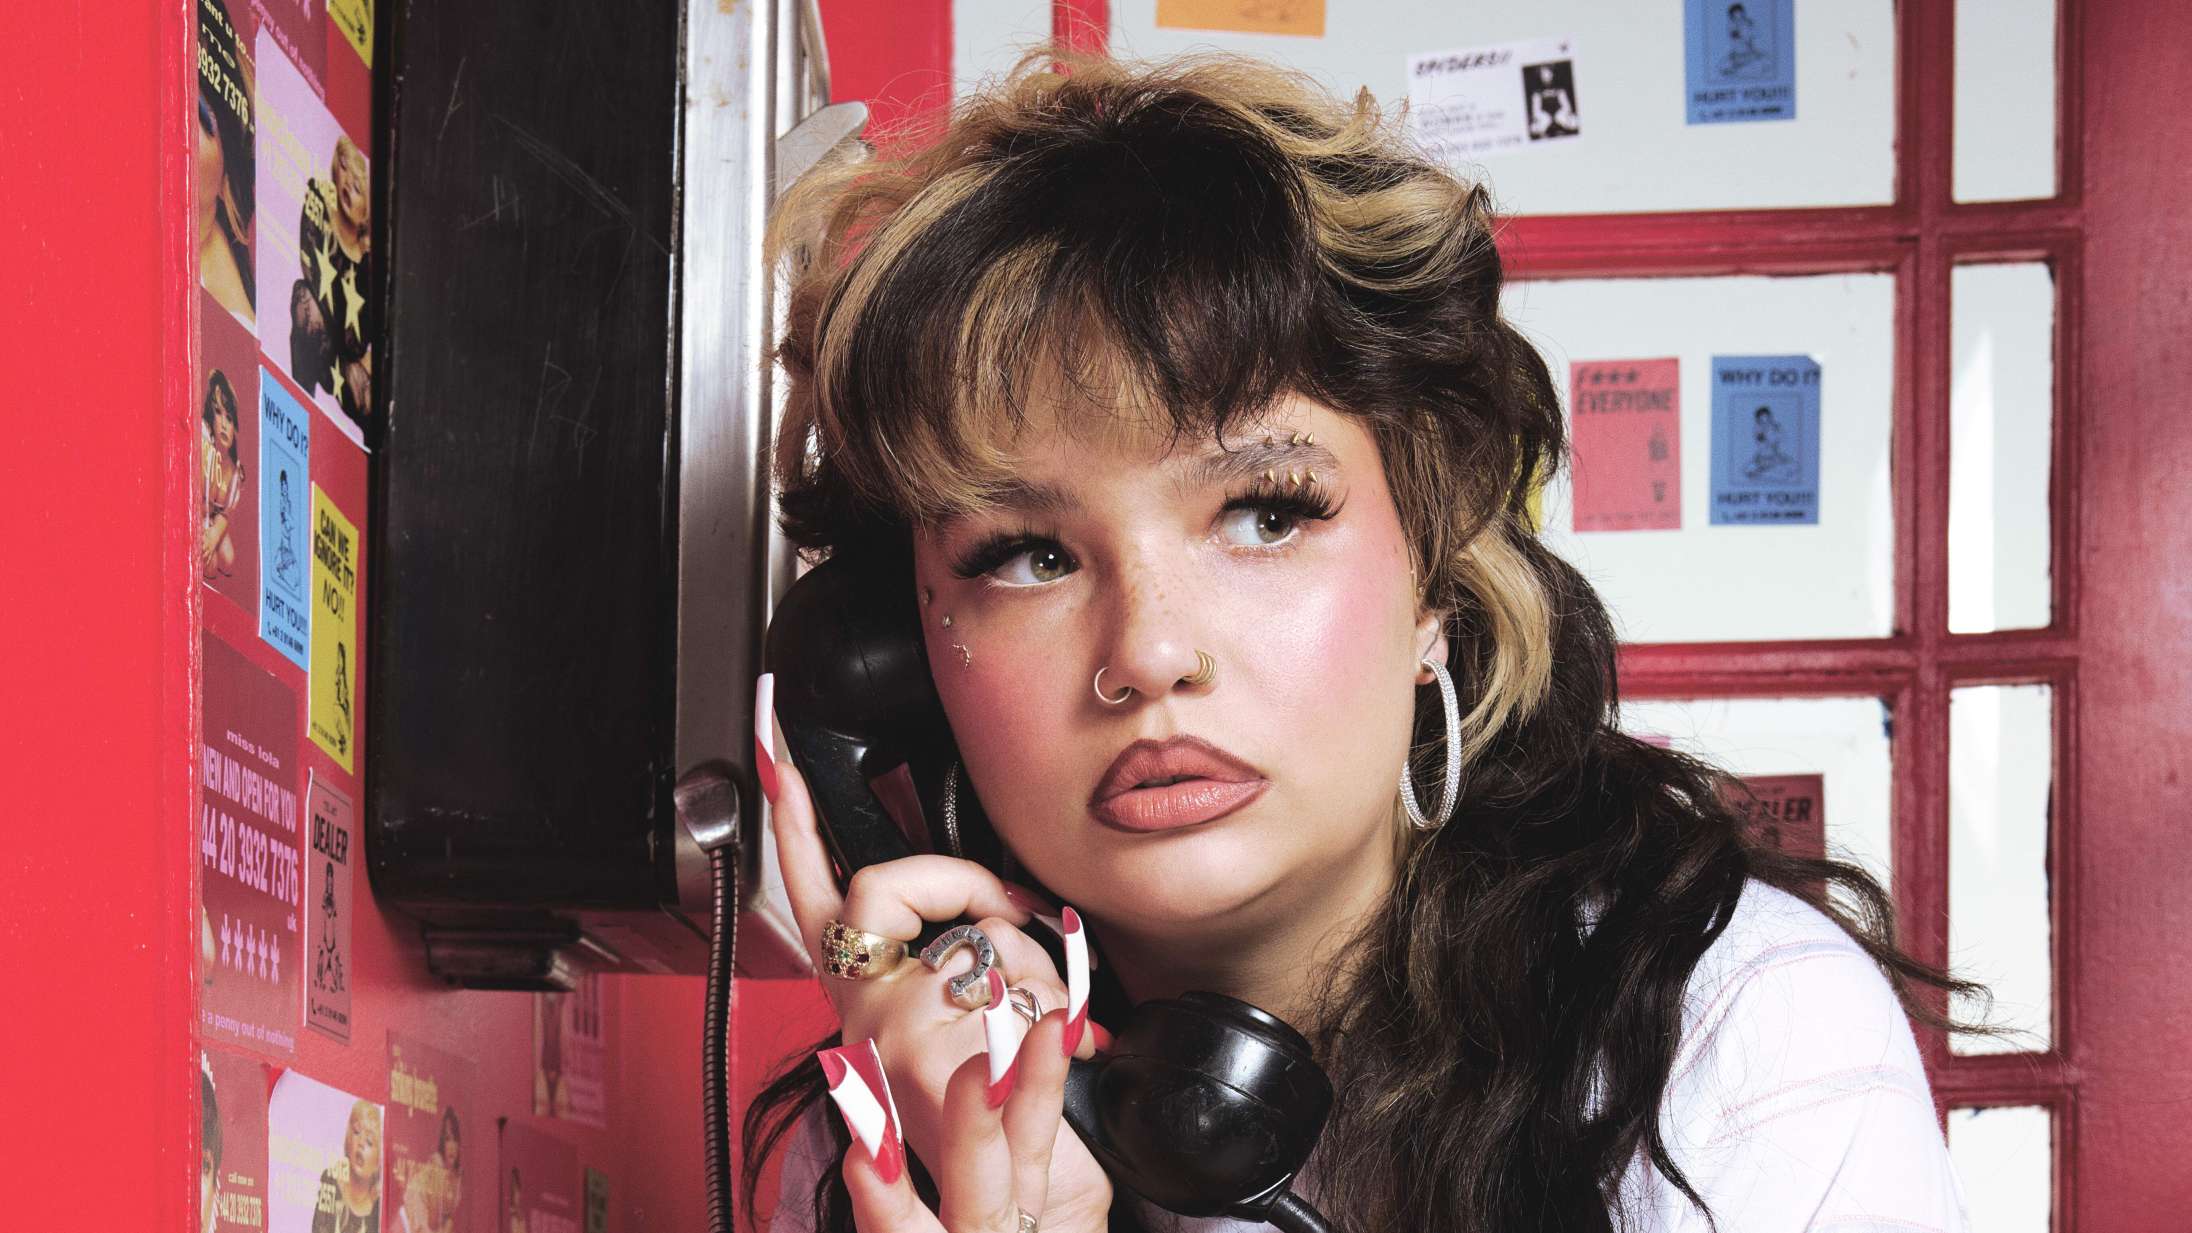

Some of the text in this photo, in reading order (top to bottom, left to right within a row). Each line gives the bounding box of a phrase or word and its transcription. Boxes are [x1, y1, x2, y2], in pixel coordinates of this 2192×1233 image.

[223, 73, 249, 125] 7376
[1719, 368, 1762, 385] WHY
[1768, 367, 1798, 386] DO
[264, 393, 285, 434] WHY
[286, 417, 299, 449] DO
[1576, 387, 1673, 416] EVERYONE
[265, 588, 285, 618] HURT
[226, 729, 280, 770] miss lola
[203, 744, 297, 833] NEW AND OPEN FOR YOU
[219, 812, 236, 878] 20
[238, 822, 268, 893] 3932
[270, 838, 299, 907] 7376
[313, 813, 348, 866] DEALER
[287, 912, 297, 932] uk
[215, 1014, 240, 1038] penny
[241, 1022, 255, 1039] out
[256, 1024, 265, 1040] of
